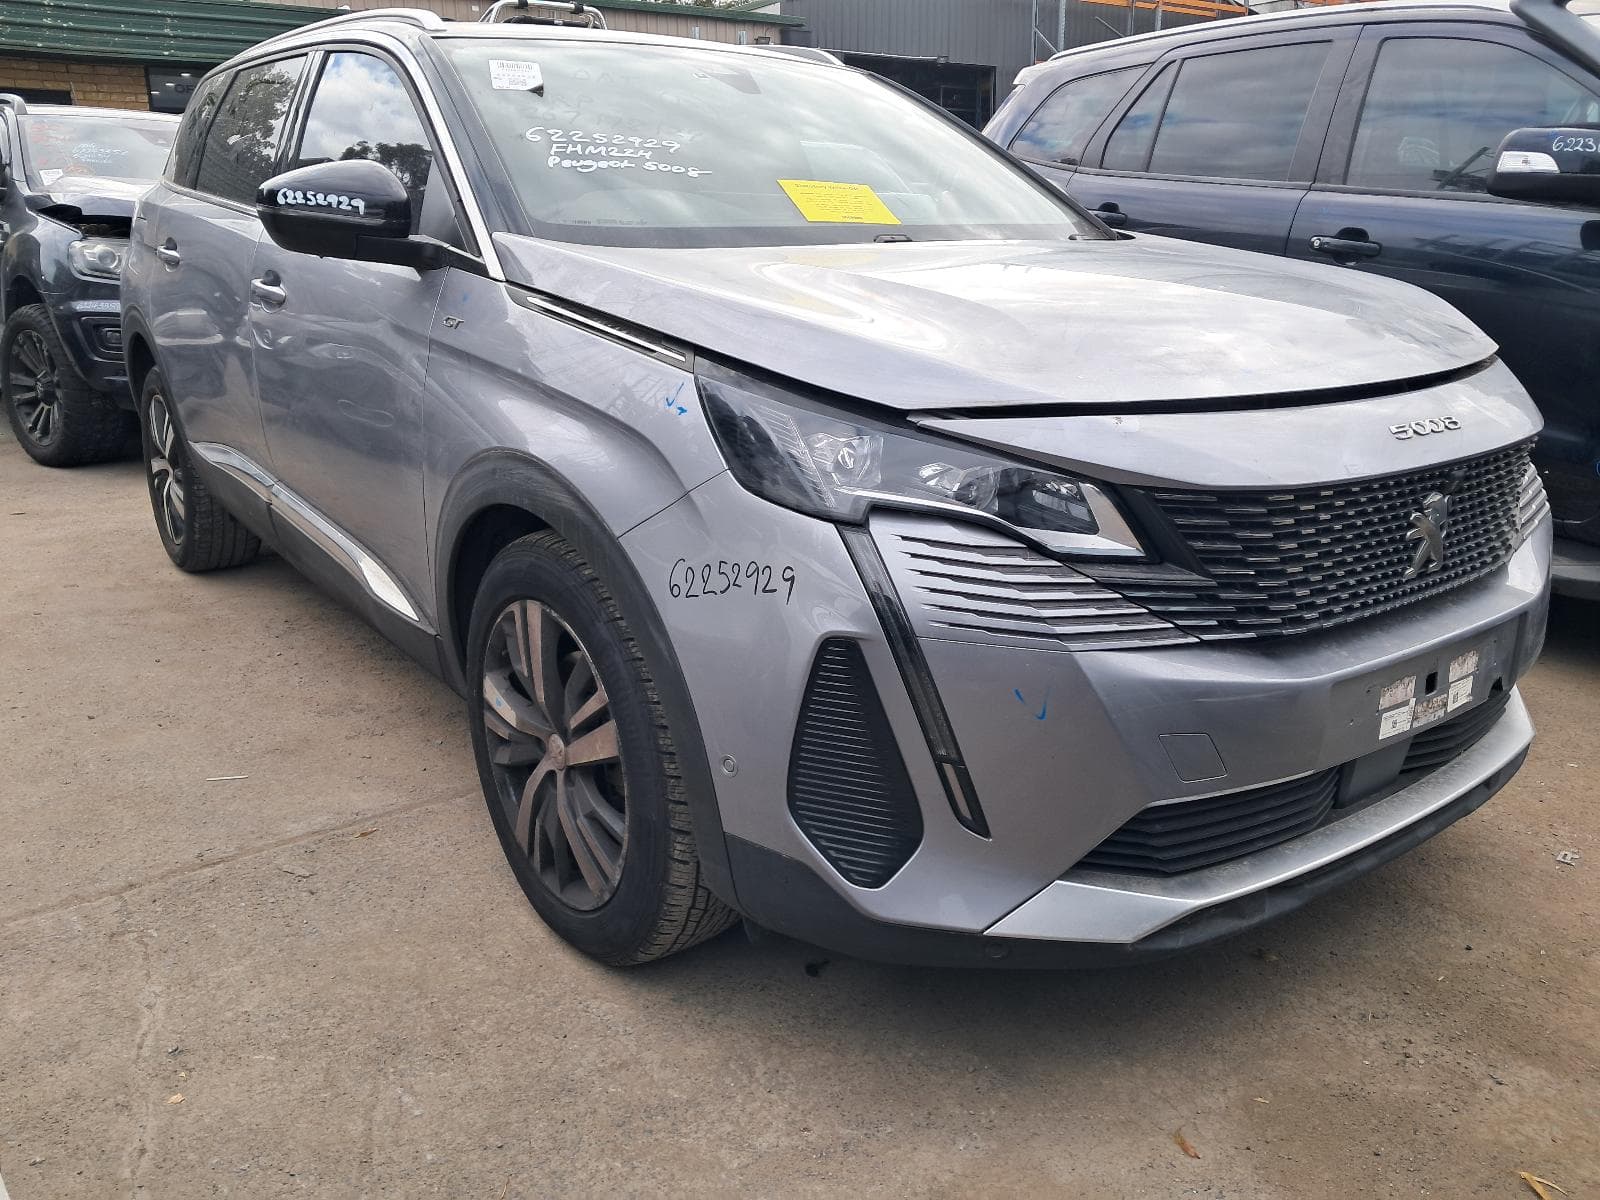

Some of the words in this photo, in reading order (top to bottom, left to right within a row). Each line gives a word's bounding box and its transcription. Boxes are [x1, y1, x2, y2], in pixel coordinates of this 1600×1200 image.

[526, 127, 680, 153] 62252929
[1552, 136, 1600, 152] 6223
[277, 187, 365, 214] 62252929
[1388, 415, 1461, 440] 5008
[669, 558, 796, 605] 62252929
